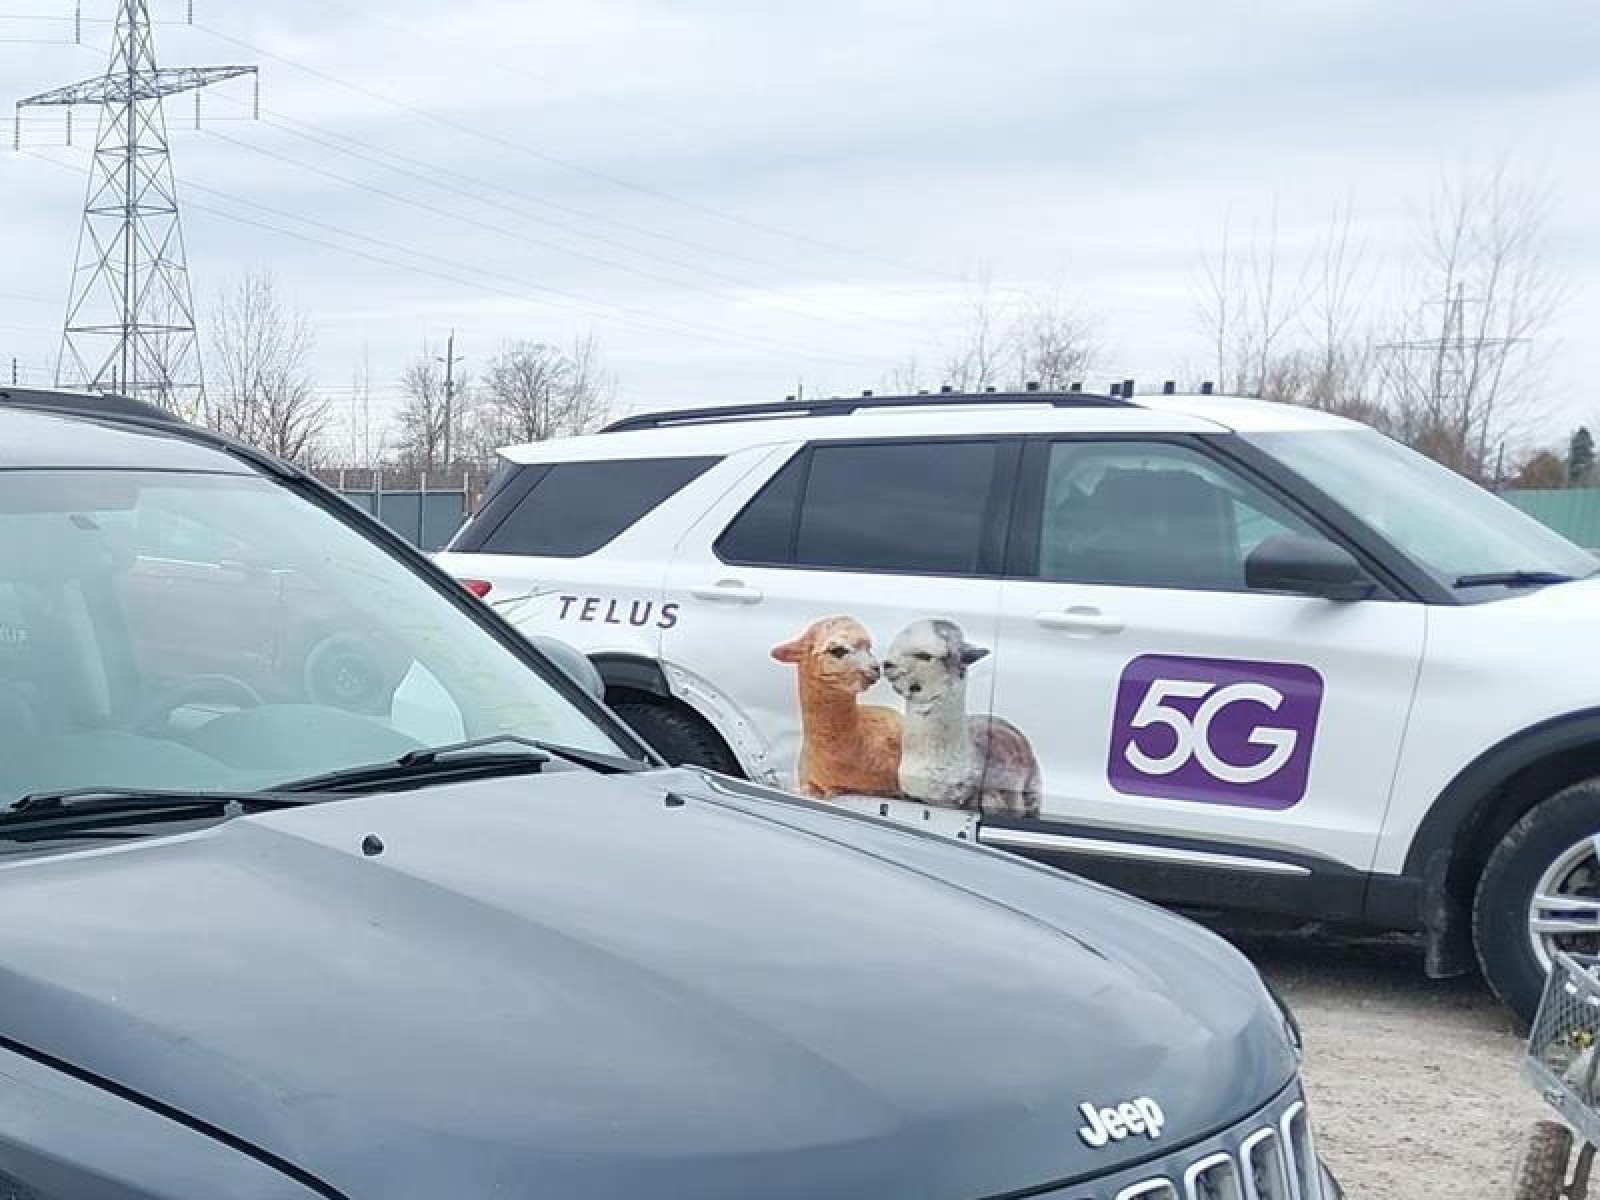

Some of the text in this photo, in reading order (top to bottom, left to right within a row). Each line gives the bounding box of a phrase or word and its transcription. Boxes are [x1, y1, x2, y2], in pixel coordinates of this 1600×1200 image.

[559, 595, 681, 629] TELUS
[1123, 679, 1298, 784] 5G
[1078, 1096, 1165, 1147] Jeep
